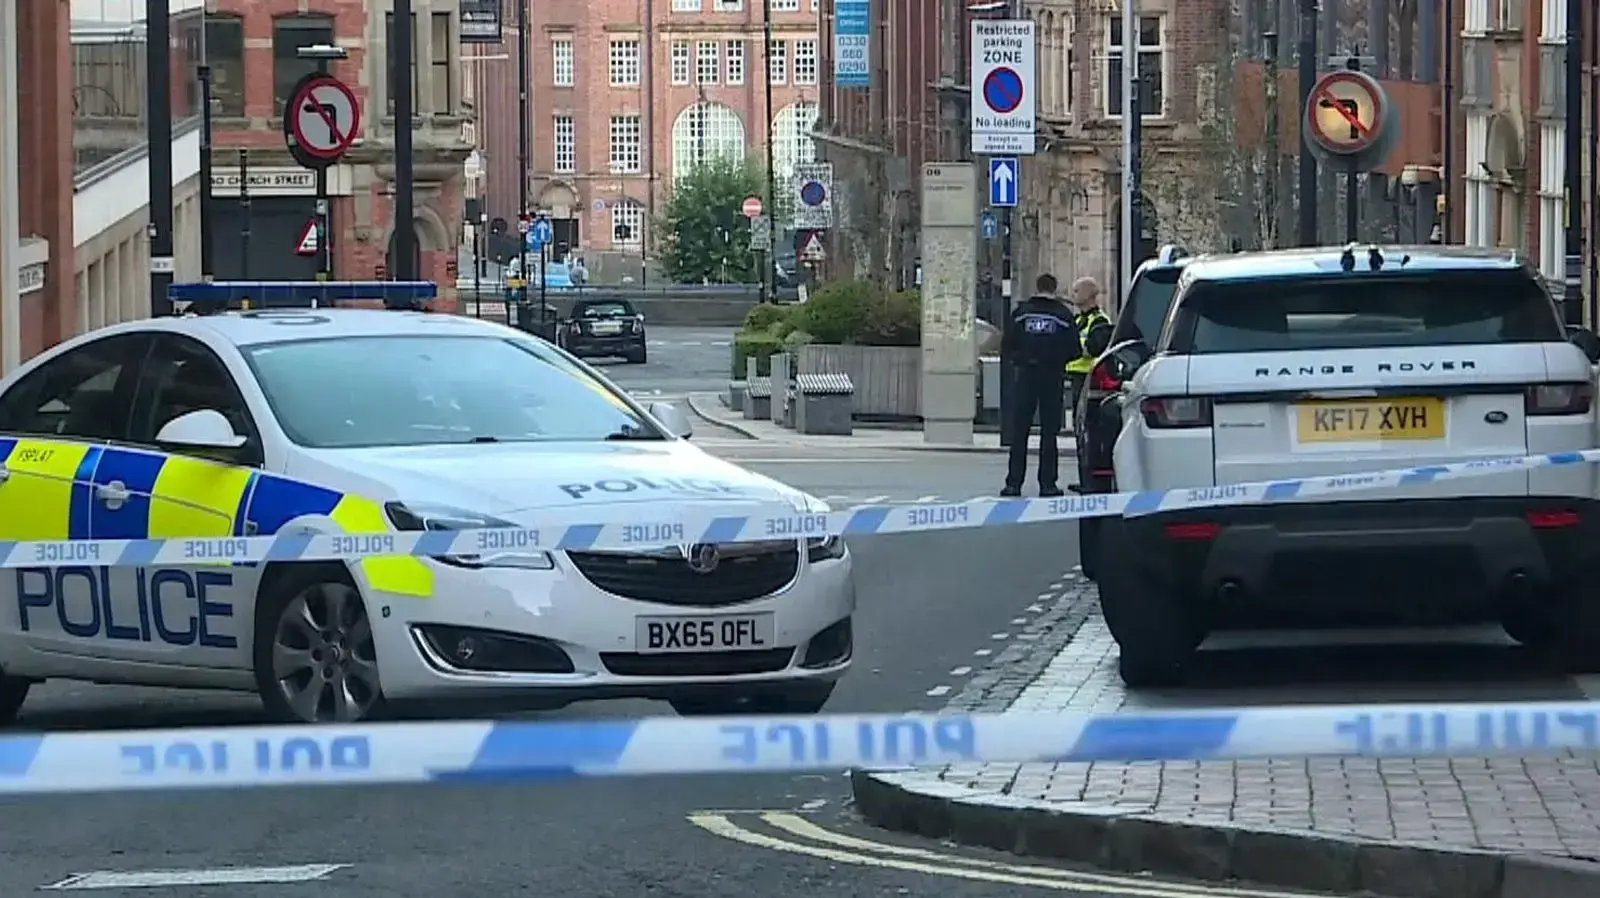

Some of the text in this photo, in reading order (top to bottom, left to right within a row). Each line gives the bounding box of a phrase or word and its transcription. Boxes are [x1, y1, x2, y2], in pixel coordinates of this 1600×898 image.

[976, 24, 1030, 35] Restricted
[838, 36, 866, 46] 0330
[983, 37, 1022, 48] parking
[983, 50, 1022, 63] ZONE
[838, 62, 866, 72] 0290
[975, 116, 1031, 129] No loading
[275, 175, 309, 184] STREET
[1255, 361, 1476, 377] RANGE ROVER
[1314, 406, 1427, 432] KF17 XVH
[558, 477, 746, 499] POLICE
[16, 565, 238, 648] POLICE
[648, 619, 764, 648] BX65 OFL
